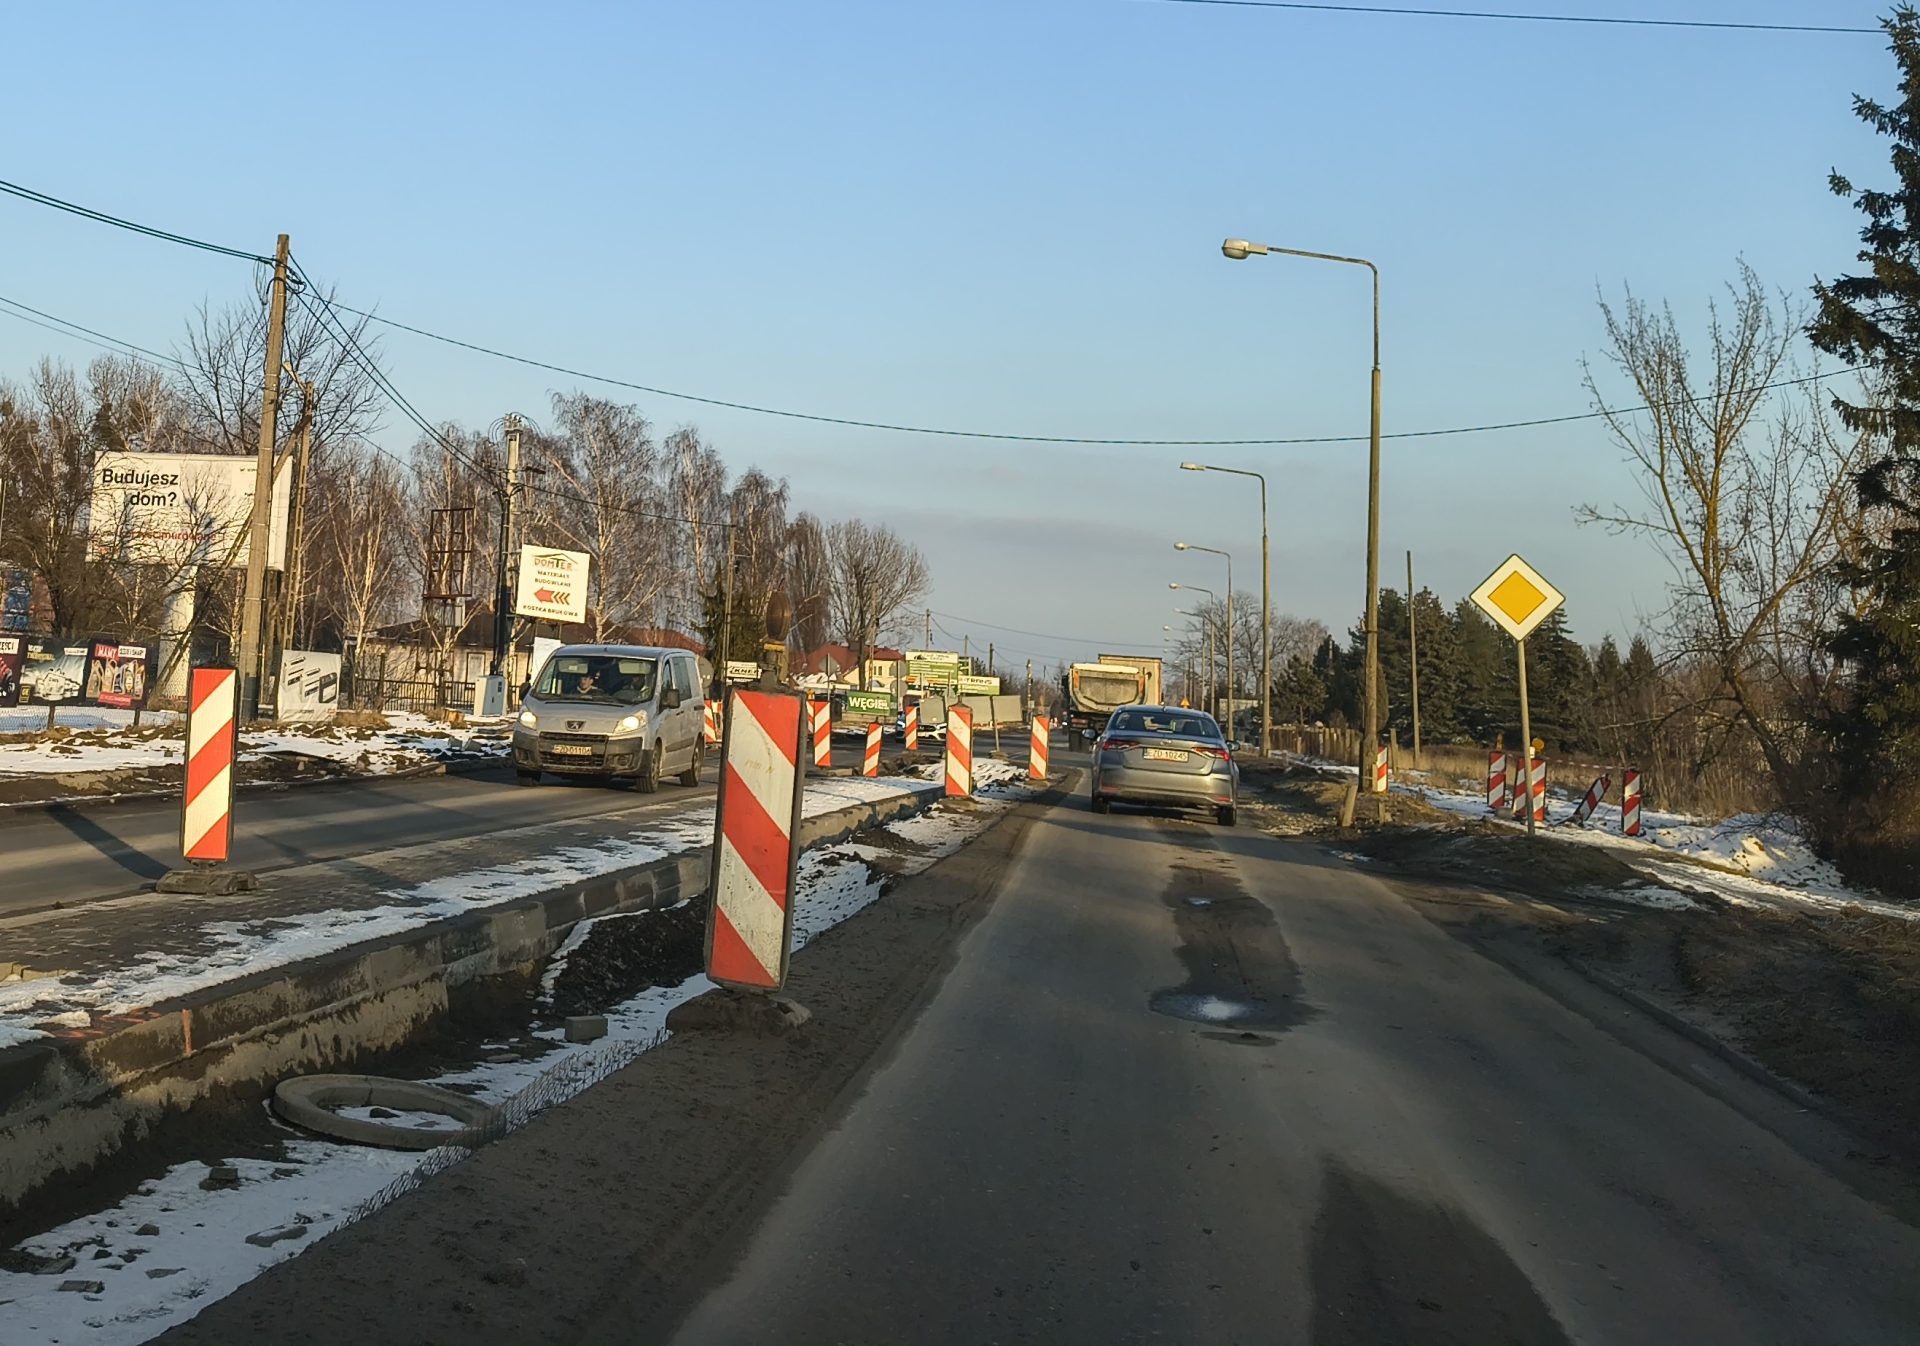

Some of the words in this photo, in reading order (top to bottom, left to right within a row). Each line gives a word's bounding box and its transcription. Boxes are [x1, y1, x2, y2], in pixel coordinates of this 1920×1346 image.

[102, 468, 179, 488] Budujesz
[129, 491, 177, 507] dom?
[534, 558, 573, 571] DOMTER
[848, 697, 890, 711] WĘGIEL
